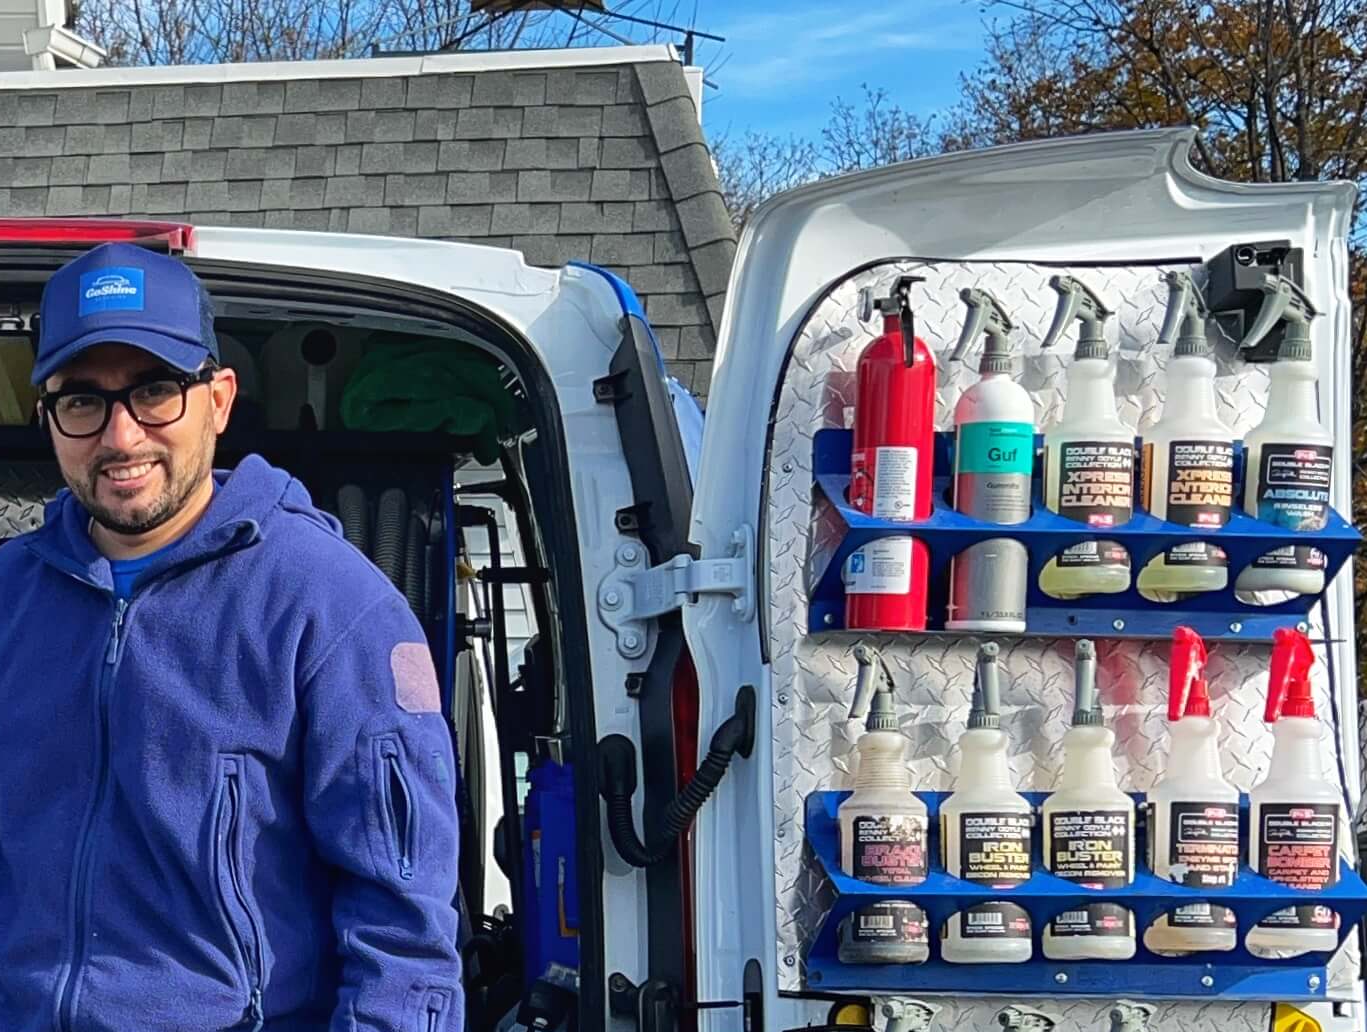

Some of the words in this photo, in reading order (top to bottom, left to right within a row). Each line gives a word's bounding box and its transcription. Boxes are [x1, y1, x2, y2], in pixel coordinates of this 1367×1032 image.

[85, 284, 137, 299] GoShine
[987, 447, 1018, 462] Guf
[1065, 447, 1107, 456] DOUBLE
[1175, 446, 1213, 455] DOUBLE
[1063, 484, 1131, 495] INTERIO
[1062, 495, 1131, 507] CLEANE
[1264, 489, 1328, 502] ABSOLUT
[965, 818, 1006, 826] DOUBLE
[1054, 816, 1093, 825] DOUBLE
[1094, 816, 1126, 825] BLACK
[983, 842, 1023, 852] IRON
[1068, 840, 1114, 851] IRON
[1056, 851, 1124, 863] BUSTER
[1268, 846, 1330, 857] CARPET
[1267, 857, 1330, 869] BOMBER
